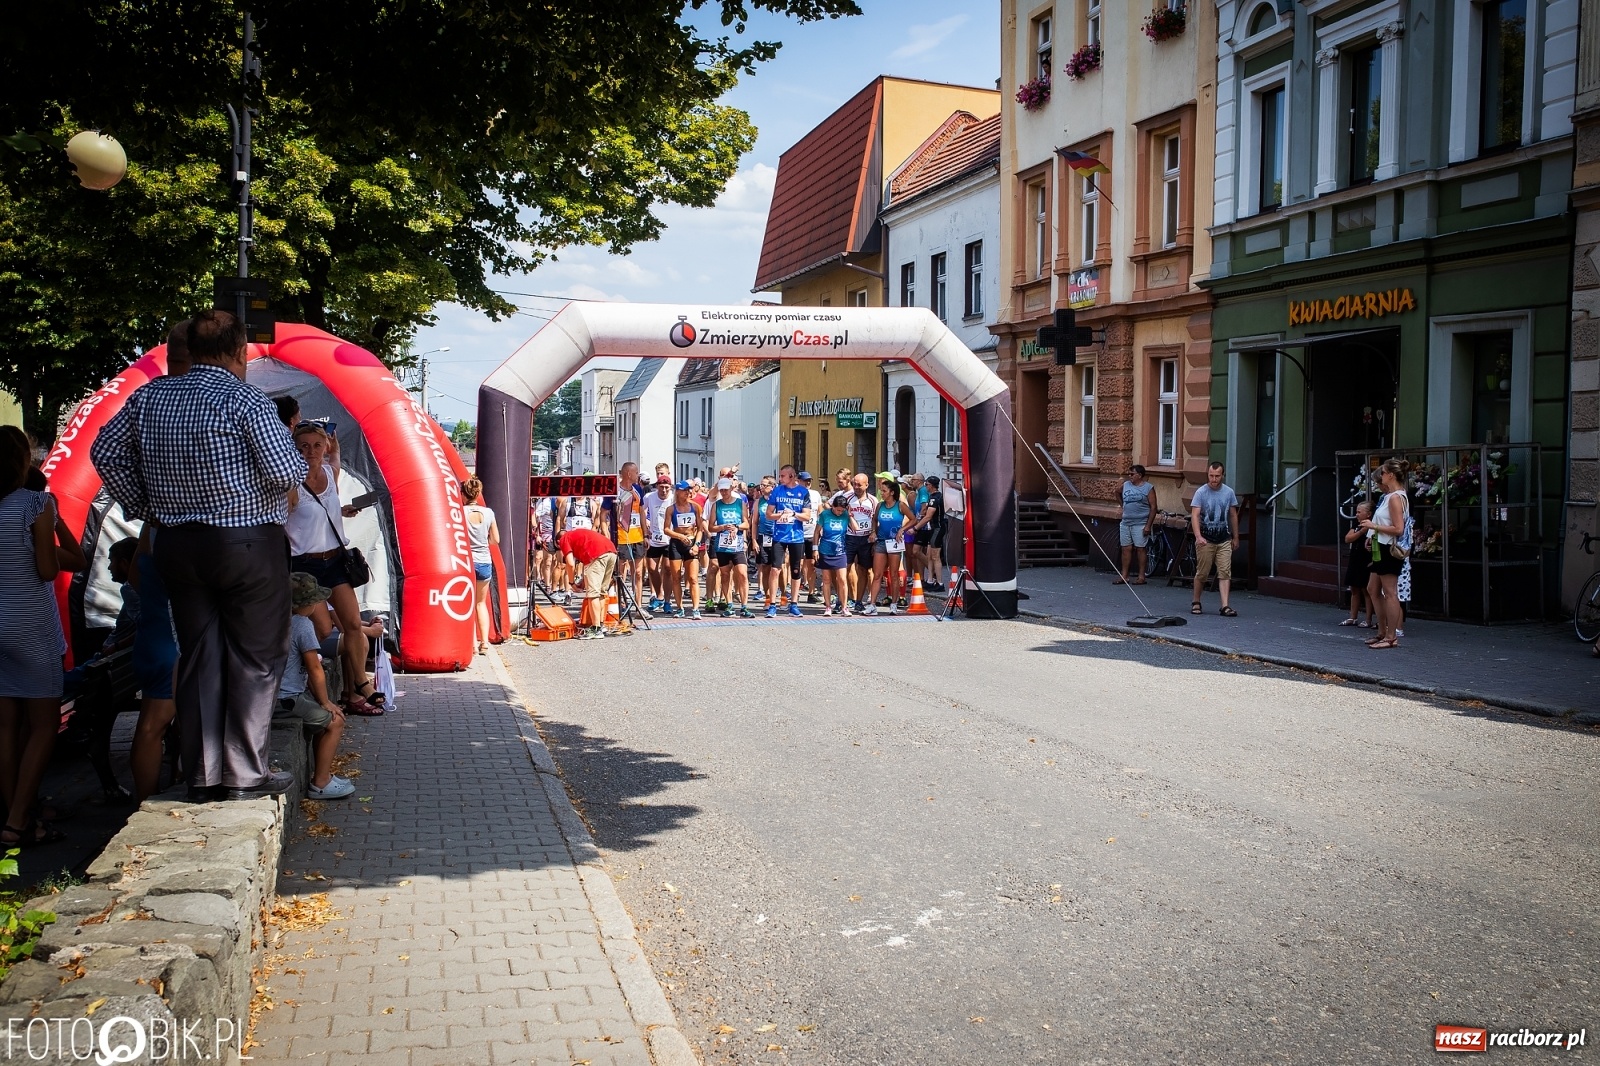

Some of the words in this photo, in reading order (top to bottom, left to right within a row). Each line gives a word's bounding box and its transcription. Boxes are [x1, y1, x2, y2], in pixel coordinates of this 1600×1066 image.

[1289, 288, 1415, 326] KWIACIARNIA
[701, 311, 774, 322] Elektroniczny
[775, 312, 811, 323] pomiar
[813, 314, 842, 322] czasu
[699, 329, 848, 349] ZmierzymyCzas.pl
[798, 401, 813, 416] BANK
[41, 377, 126, 492] myCzas.pl
[859, 521, 869, 529] 56
[655, 534, 663, 542] 44
[723, 538, 733, 546] 33
